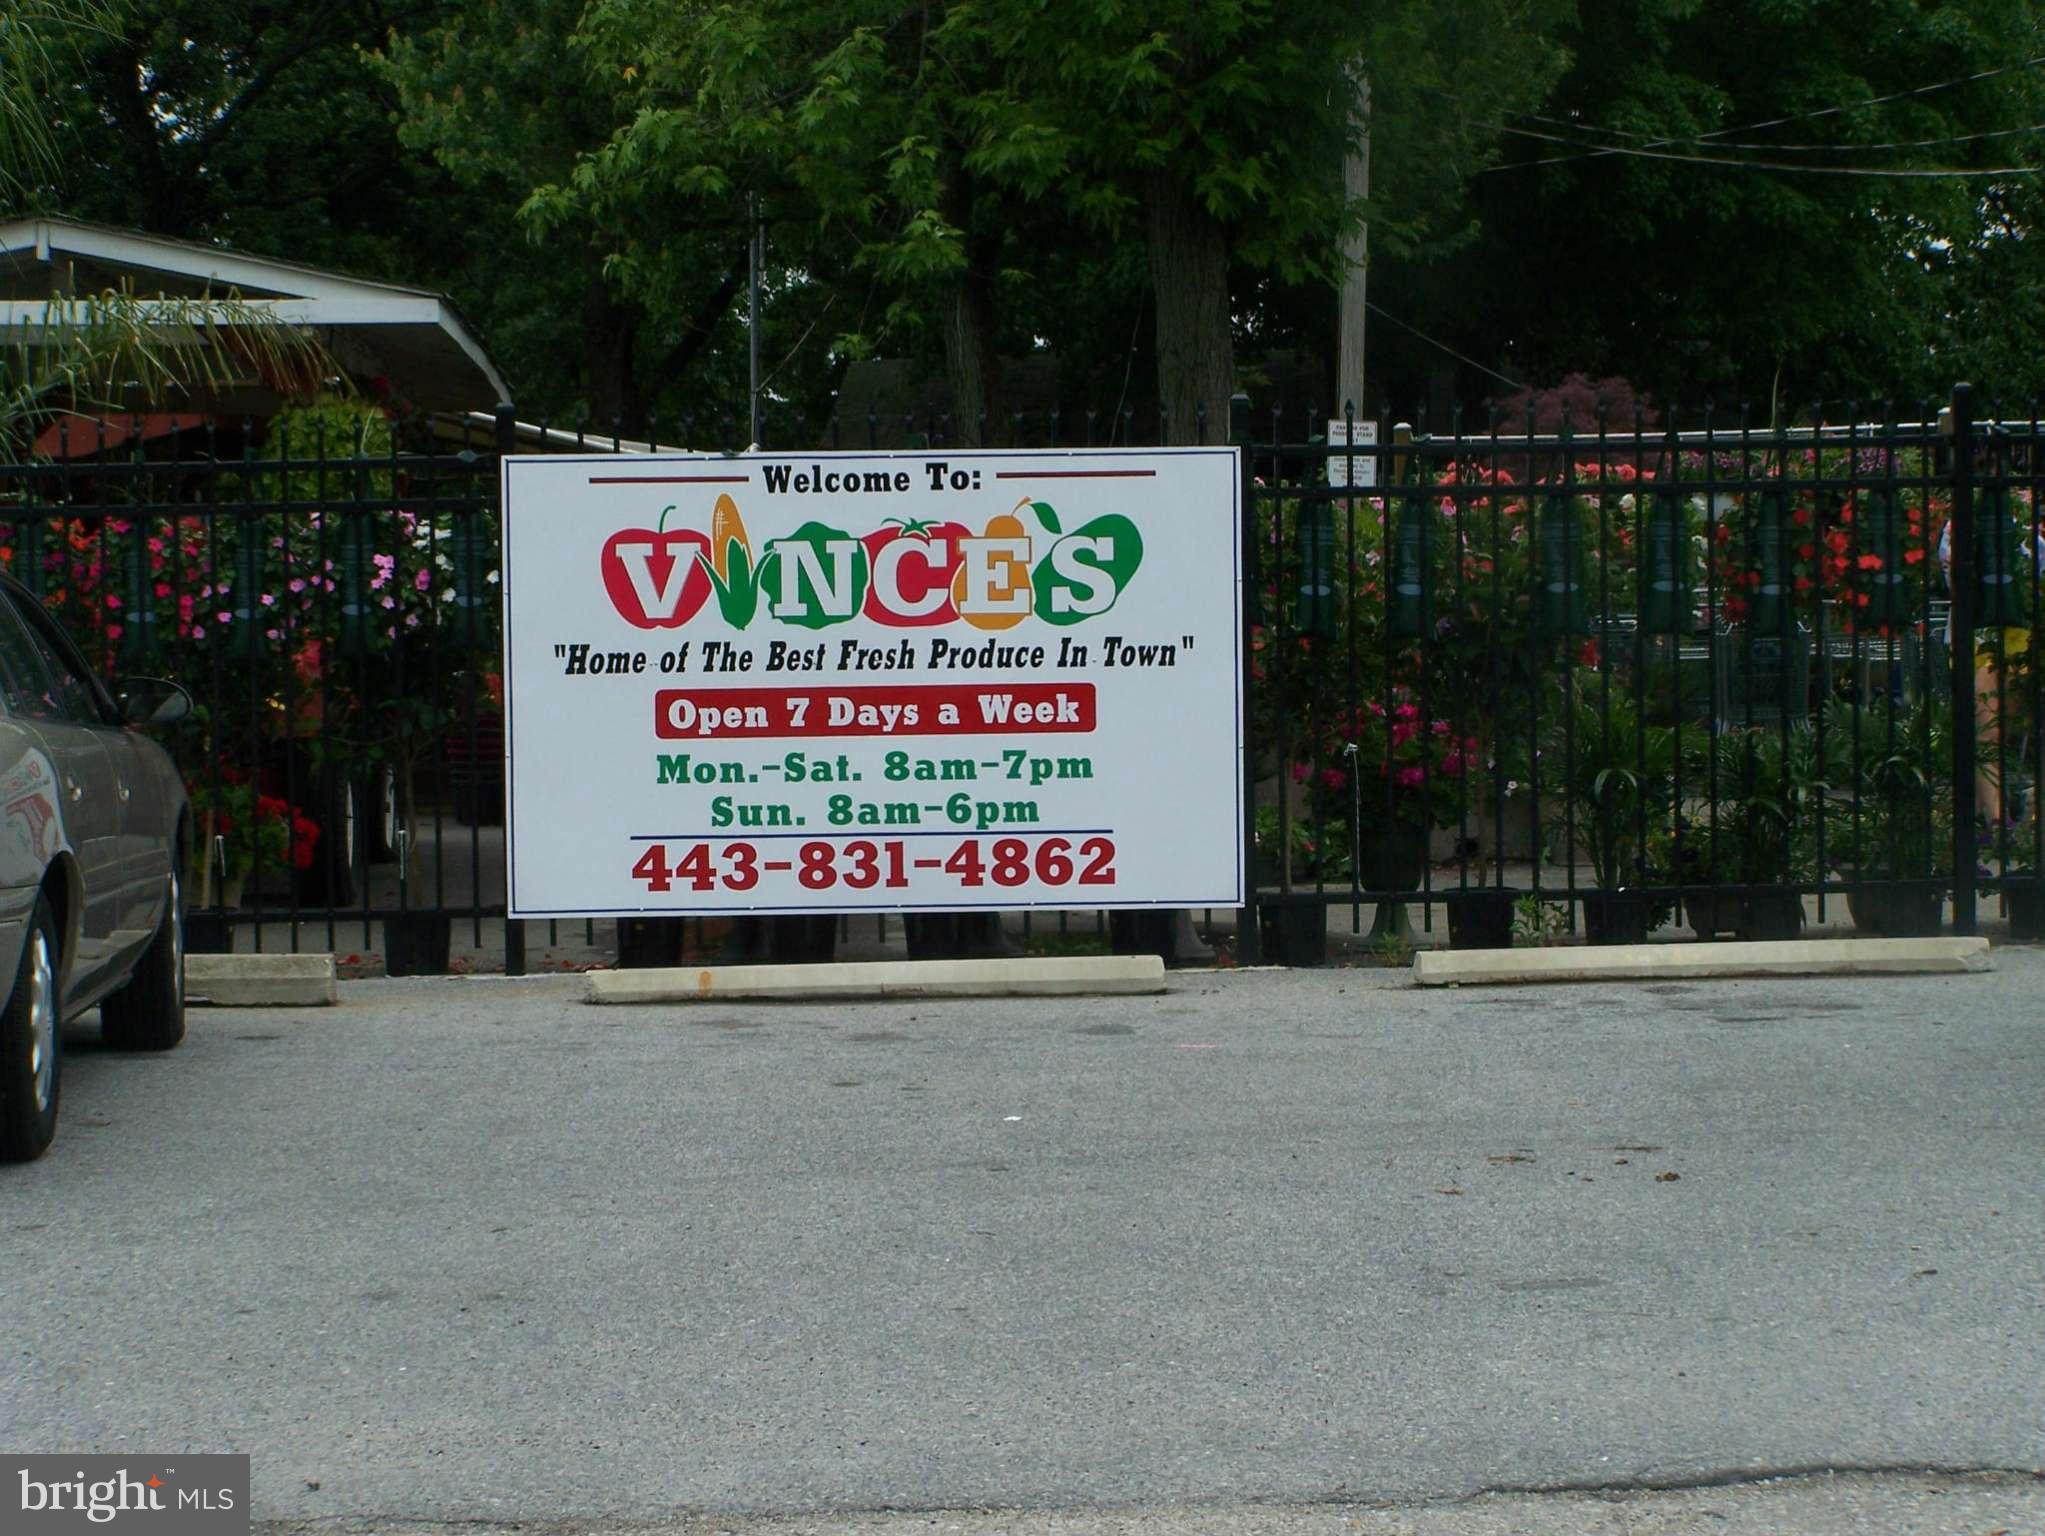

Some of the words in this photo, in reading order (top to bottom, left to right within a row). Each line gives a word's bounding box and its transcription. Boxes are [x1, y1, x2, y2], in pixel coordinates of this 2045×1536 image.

[763, 465, 910, 493] Welcome
[925, 462, 981, 491] To:
[553, 644, 647, 674] "Home
[660, 641, 690, 672] of
[702, 641, 752, 672] The
[766, 641, 826, 671] Best
[837, 639, 915, 671] Fresh
[927, 638, 1045, 669] Produce
[1056, 637, 1088, 668] In
[1103, 635, 1195, 667] Town"
[668, 698, 768, 735] Open
[786, 697, 811, 728] 7
[828, 696, 920, 732] Days
[938, 702, 961, 725] a
[977, 693, 1080, 725] Week
[656, 752, 863, 784] Mon.-Sat.
[883, 749, 1094, 786] 8am-7pm
[711, 796, 806, 827] Sun.
[827, 792, 1040, 830] 8am-6pm
[631, 837, 1117, 892] 443-831-4862
